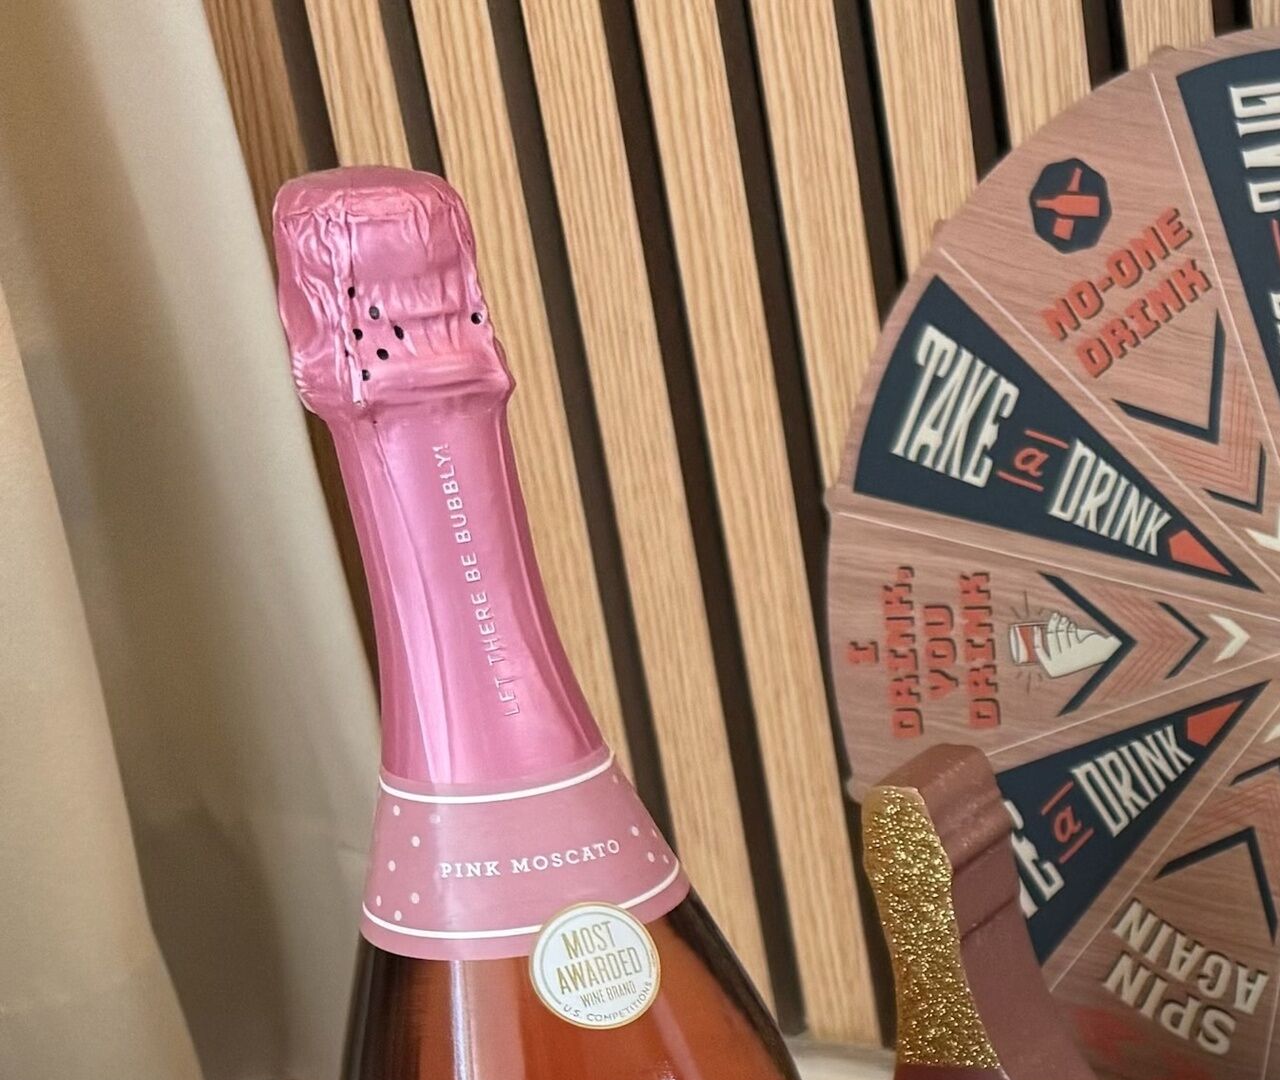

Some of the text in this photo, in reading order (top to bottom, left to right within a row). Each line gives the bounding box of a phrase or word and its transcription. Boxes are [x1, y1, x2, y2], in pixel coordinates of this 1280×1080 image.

[1038, 207, 1194, 342] NO-ONE
[1073, 259, 1213, 379] DRINK
[890, 323, 1172, 557] TAKE a DRINK
[433, 442, 521, 717] LET THERE BE BUBBLY!
[848, 640, 880, 665] I
[881, 564, 925, 739] DRINK,
[924, 603, 961, 700] YOU
[960, 570, 1001, 731] DRINK
[1070, 723, 1195, 839] DRINK
[440, 839, 621, 879] PINK MOSCATO
[556, 946, 643, 996] AWARDED
[561, 920, 616, 960] MOST
[580, 981, 637, 1008] WINE BRAND
[1110, 897, 1270, 1017] AGAIN
[586, 981, 653, 1023] COMPETITIONS
[1102, 947, 1238, 1058] SPIN
